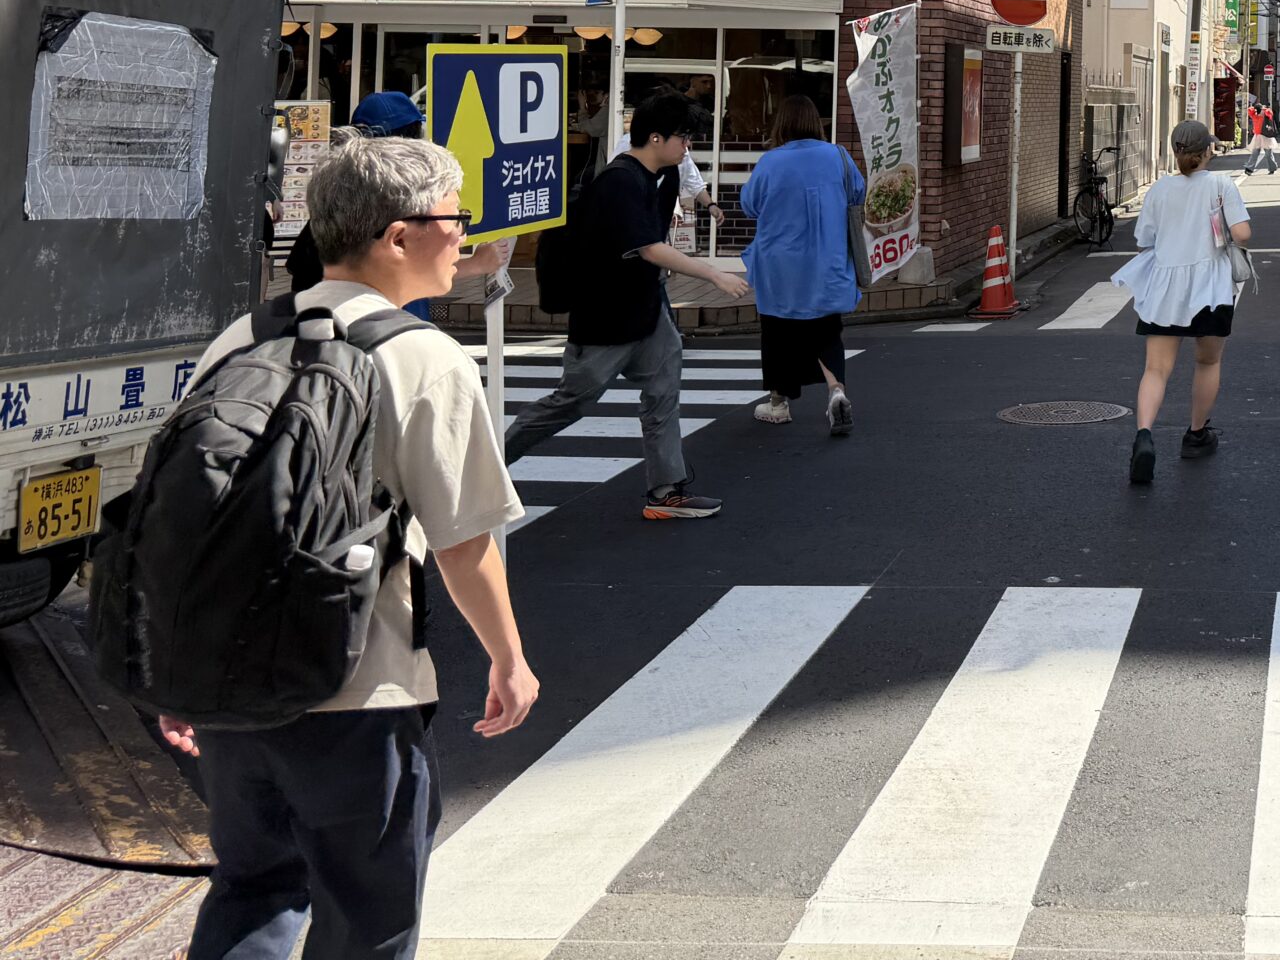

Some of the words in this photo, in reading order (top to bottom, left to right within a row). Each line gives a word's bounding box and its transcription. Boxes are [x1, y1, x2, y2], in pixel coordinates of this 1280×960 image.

[991, 31, 1051, 48] 自転車を除く
[519, 71, 544, 134] P
[502, 155, 556, 187] ジョイナス
[508, 187, 549, 221] 高島屋
[31, 425, 54, 442] 横浜
[59, 422, 80, 438] TEL
[41, 480, 63, 501] 横浜
[64, 476, 84, 494] 483
[37, 494, 92, 540] 85-51
